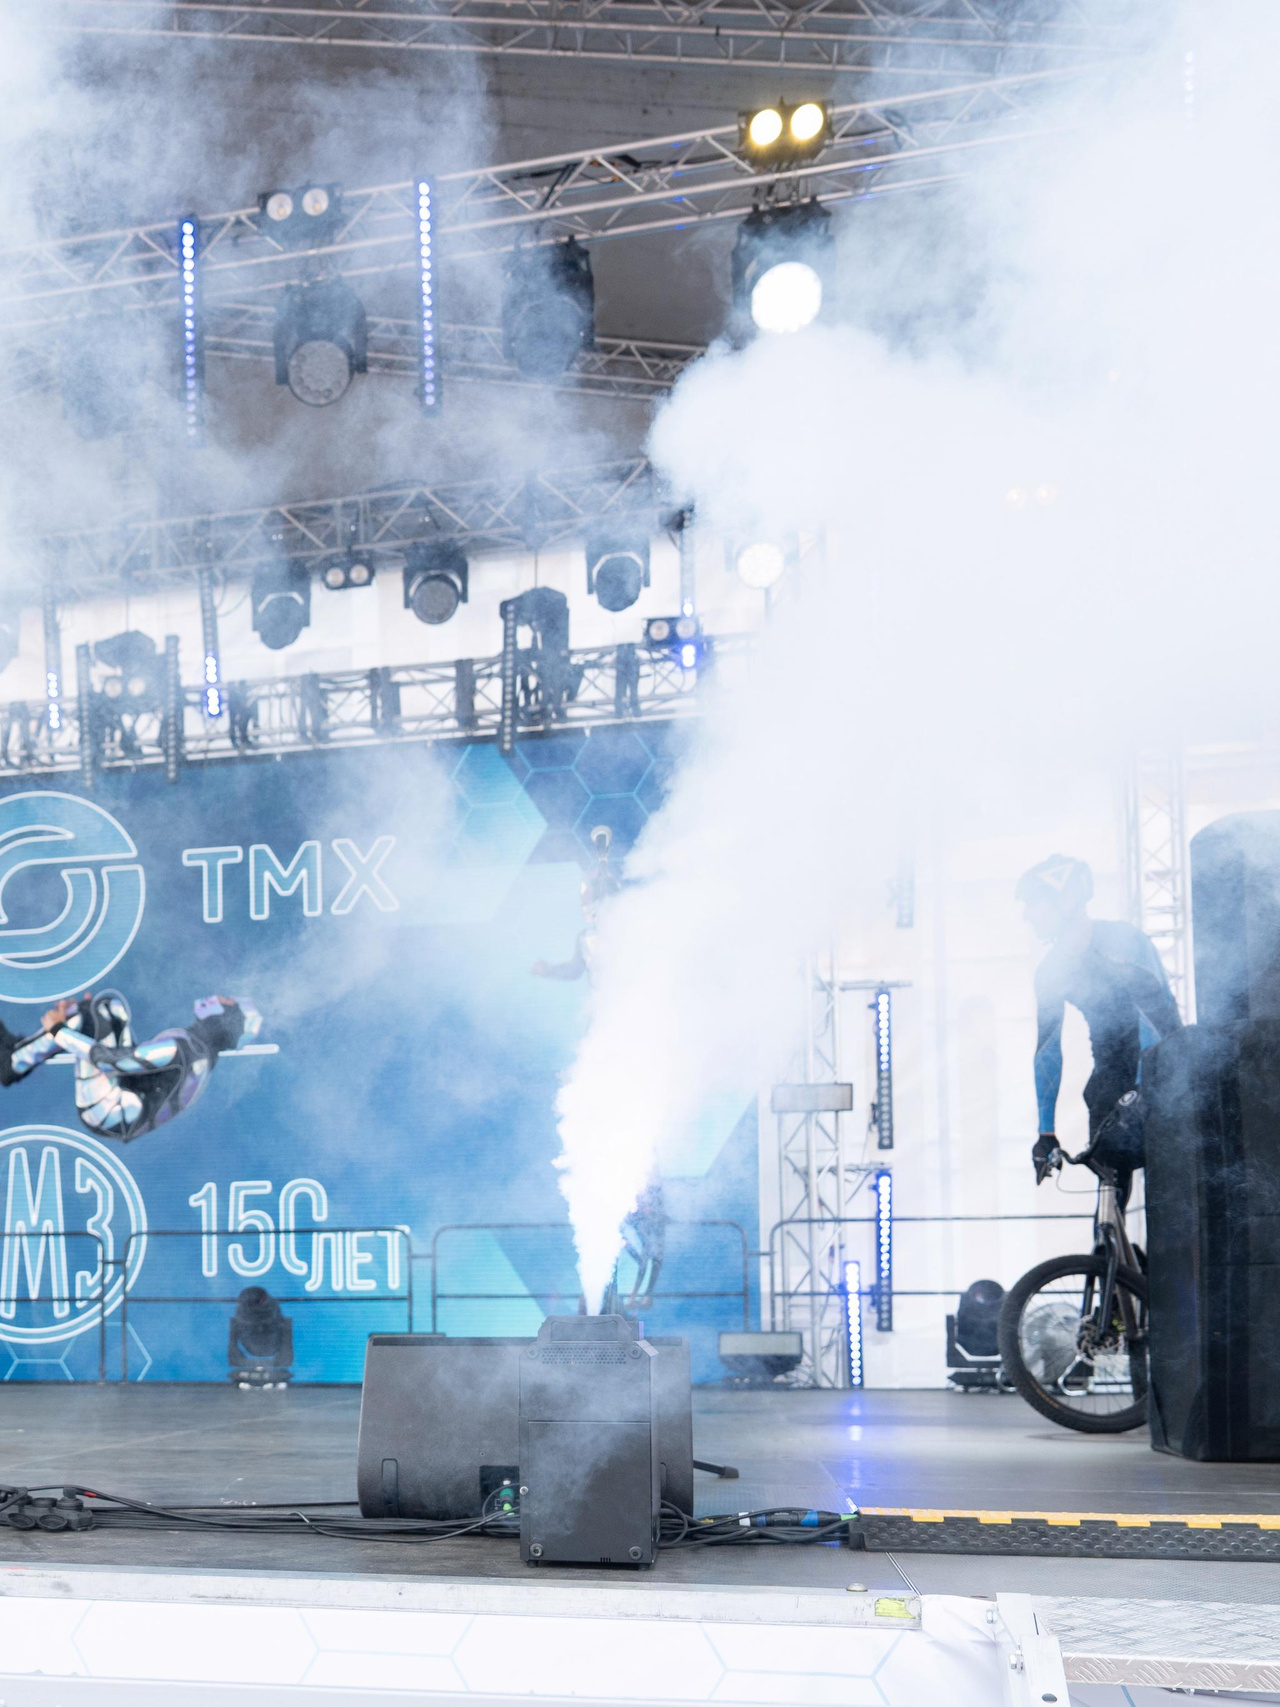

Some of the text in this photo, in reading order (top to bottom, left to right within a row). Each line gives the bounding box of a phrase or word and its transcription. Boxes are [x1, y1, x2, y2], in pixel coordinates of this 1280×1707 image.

[182, 835, 400, 923] ТМХ
[189, 1178, 410, 1291] 150 ЛЕТ
